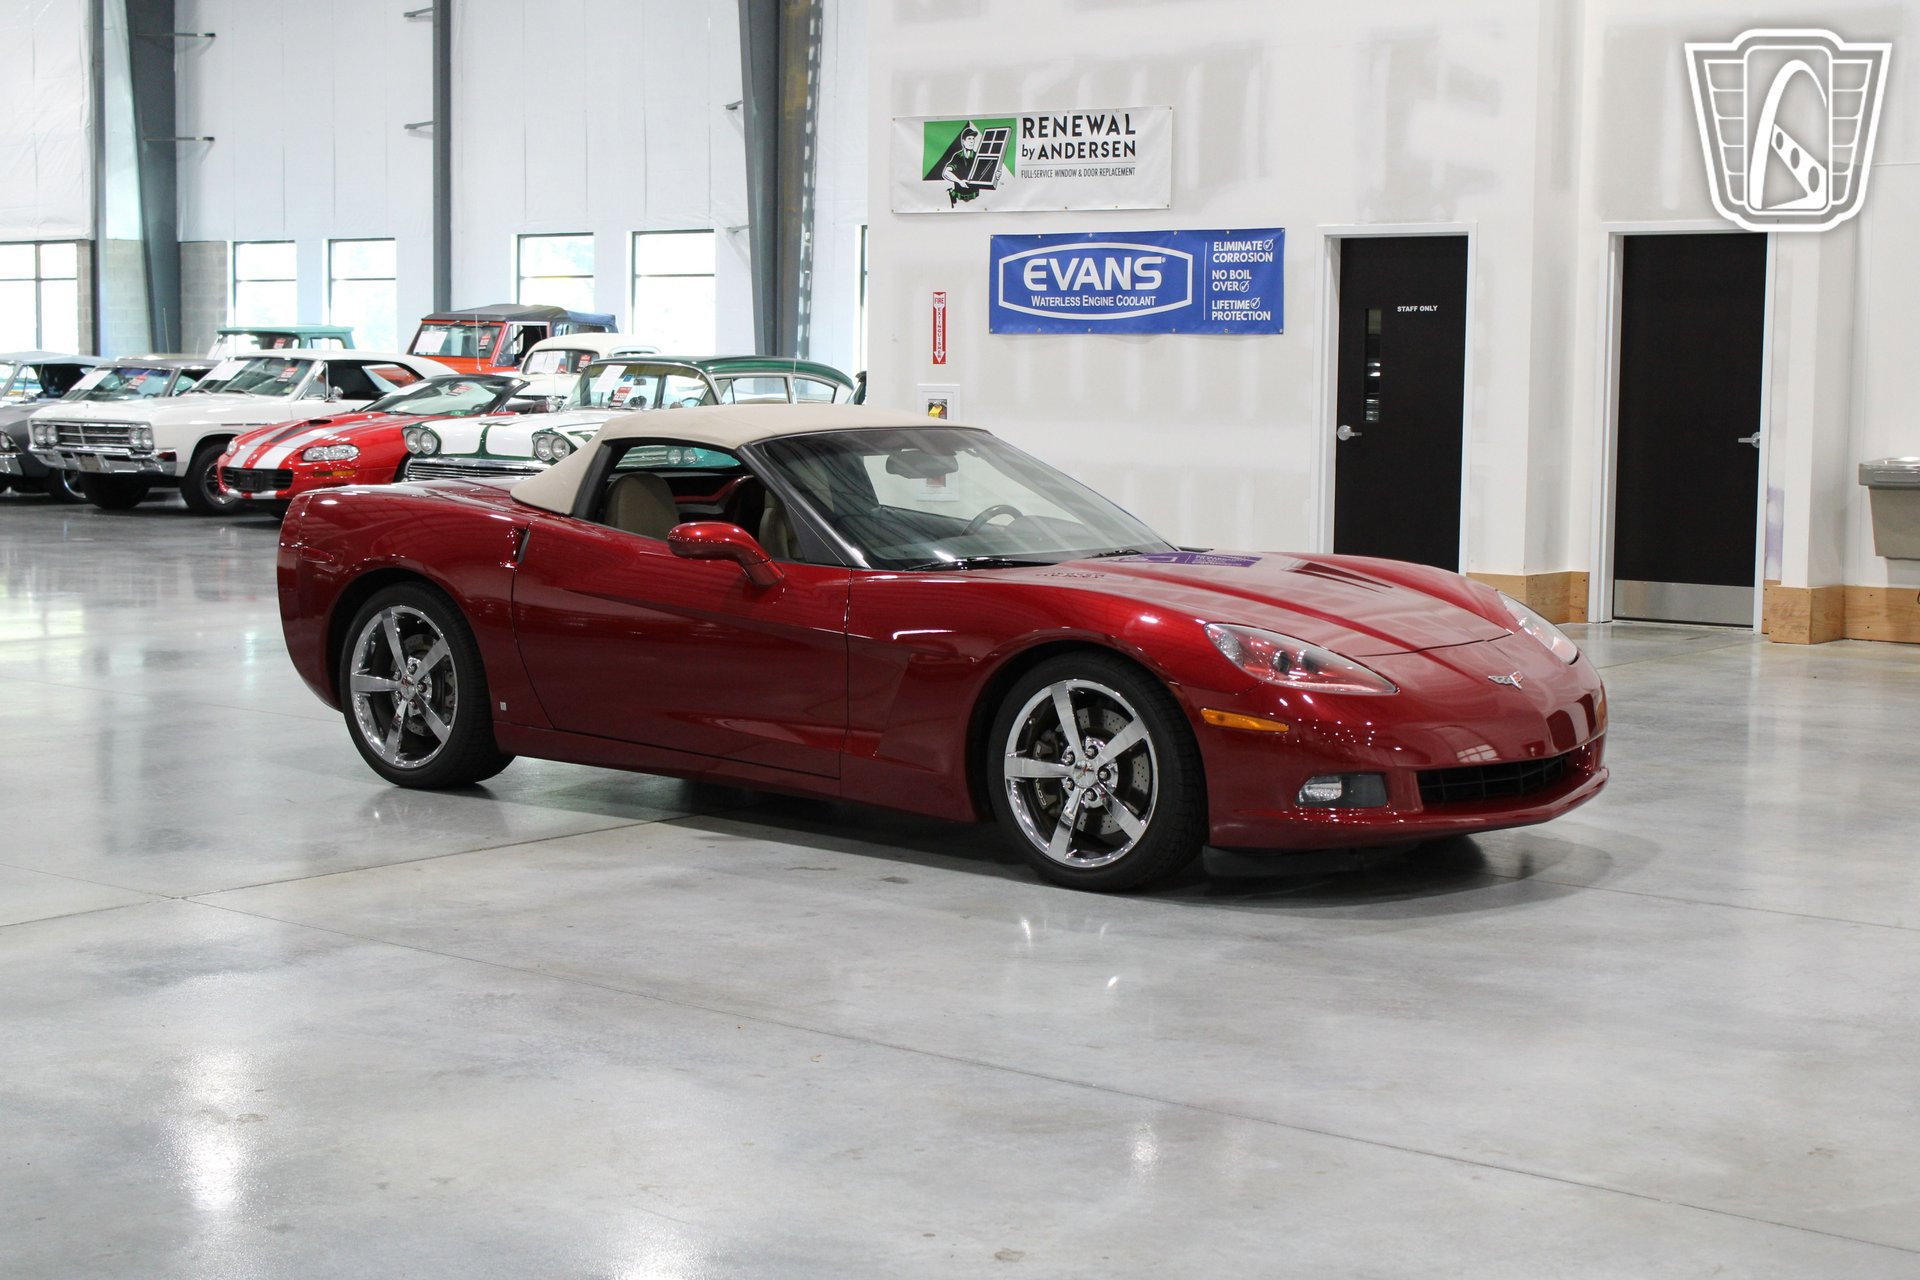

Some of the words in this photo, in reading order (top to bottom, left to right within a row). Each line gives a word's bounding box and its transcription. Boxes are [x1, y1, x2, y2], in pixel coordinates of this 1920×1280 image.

[1022, 113, 1136, 139] RENEWAL
[1021, 144, 1035, 160] by
[1037, 140, 1136, 160] ANDERSEN
[1021, 169, 1053, 178] FULL-SERVICE
[1055, 168, 1077, 177] WINDOW
[1083, 168, 1098, 177] DOOR
[1099, 167, 1135, 176] REPLACEMENT
[1213, 241, 1263, 252] ELIMINATE
[1212, 252, 1273, 263] CORROSION
[1023, 256, 1163, 291] EVANS
[1212, 269, 1227, 280] NO
[1229, 269, 1252, 280] BOIL
[1212, 281, 1239, 291] OVER
[1031, 295, 1080, 307] WATERLESS
[1083, 294, 1114, 307] ENGINE
[1116, 294, 1156, 306] COOLANT
[1212, 300, 1250, 310] LIFETIME
[1211, 311, 1271, 321] PROTECTION
